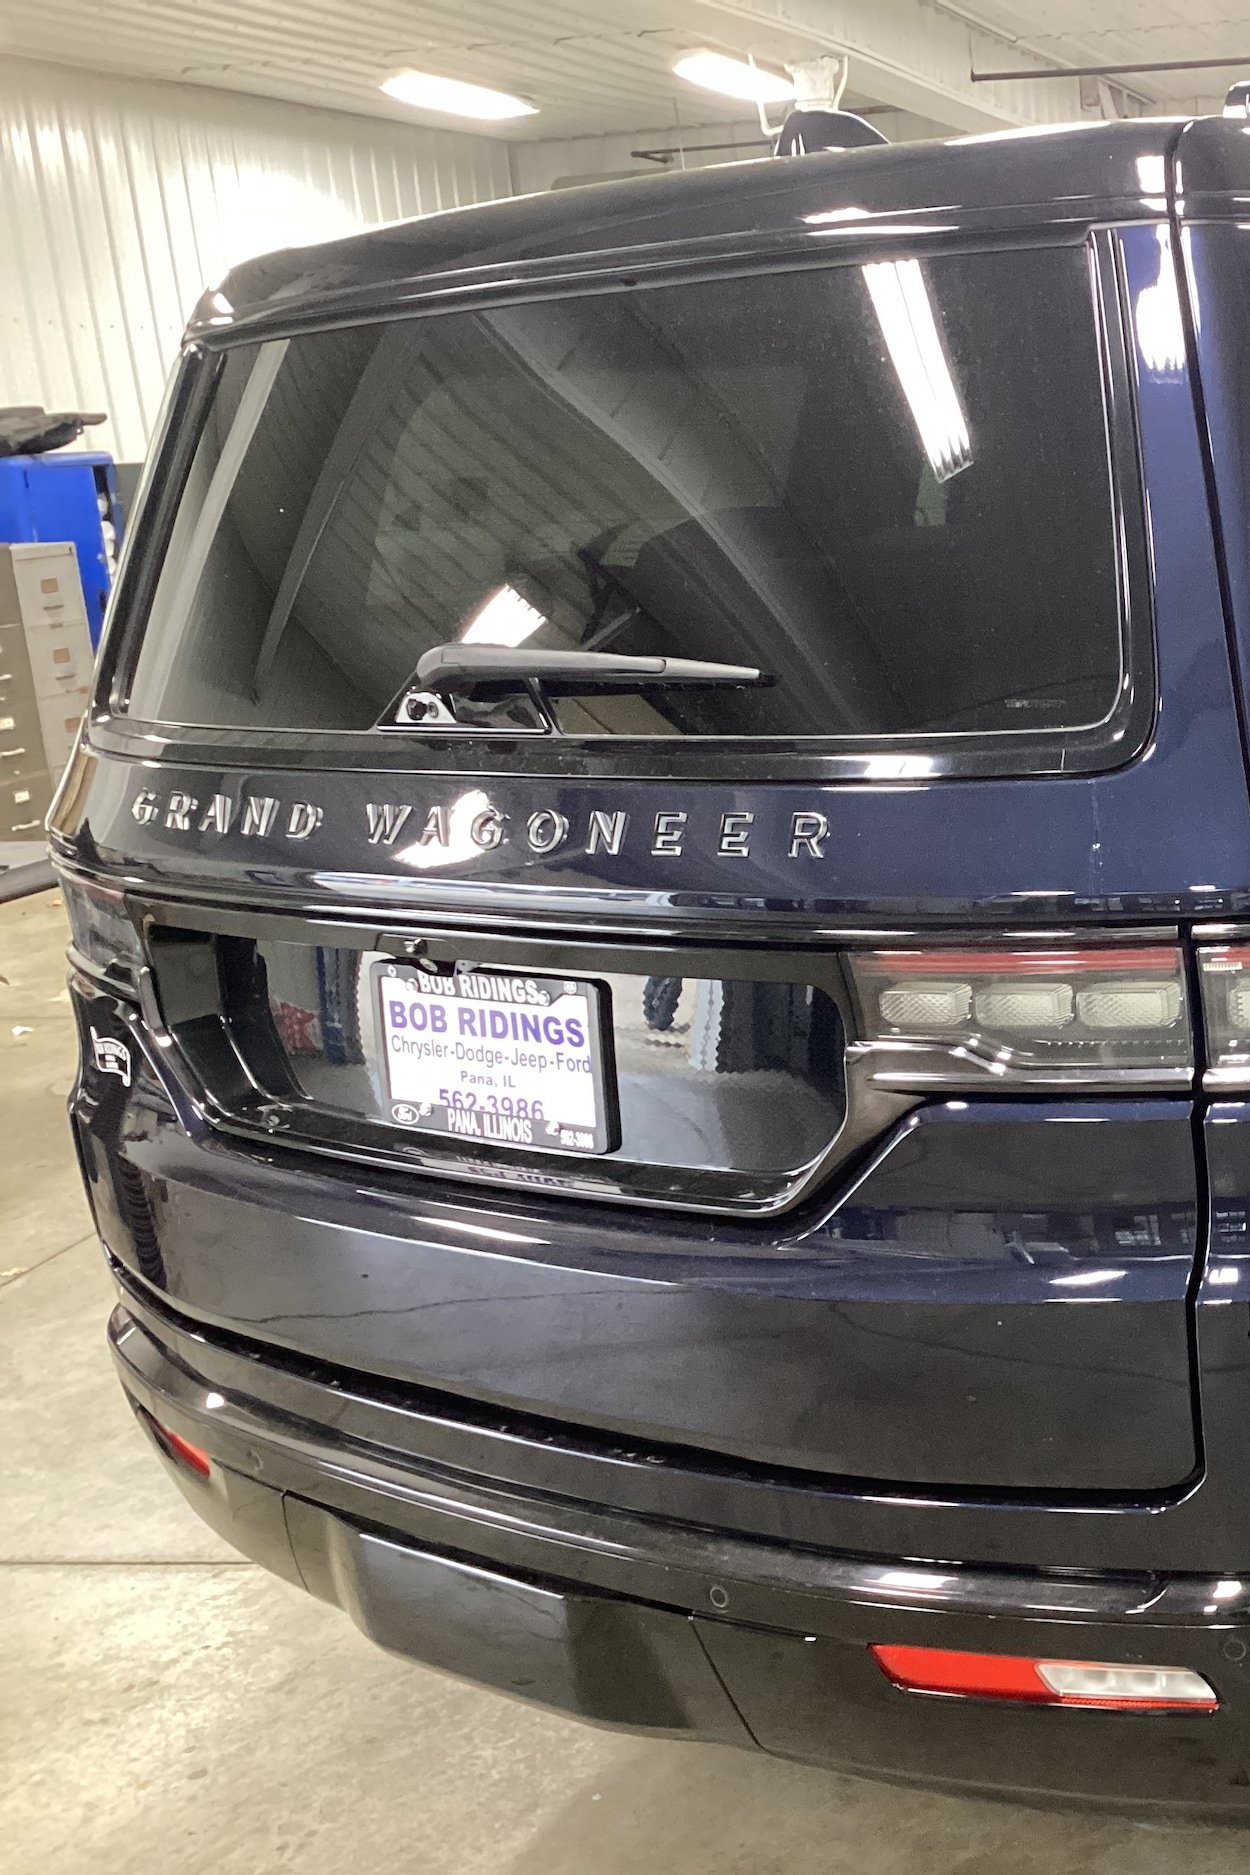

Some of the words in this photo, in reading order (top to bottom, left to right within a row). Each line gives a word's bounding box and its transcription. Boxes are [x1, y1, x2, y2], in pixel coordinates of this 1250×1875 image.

[131, 787, 324, 841] GRAND
[365, 802, 832, 859] WAGONEER
[458, 973, 541, 1005] RIDINGS
[389, 1000, 448, 1033] BOB
[457, 1006, 586, 1048] RIDINGS
[391, 1034, 593, 1074] Chrysler-Dodge-Jeep-Ford
[460, 1070, 498, 1088] Pana,
[503, 1074, 517, 1088] IL
[438, 1088, 545, 1121] 562-3986
[483, 1113, 533, 1144] ILLINOIS
